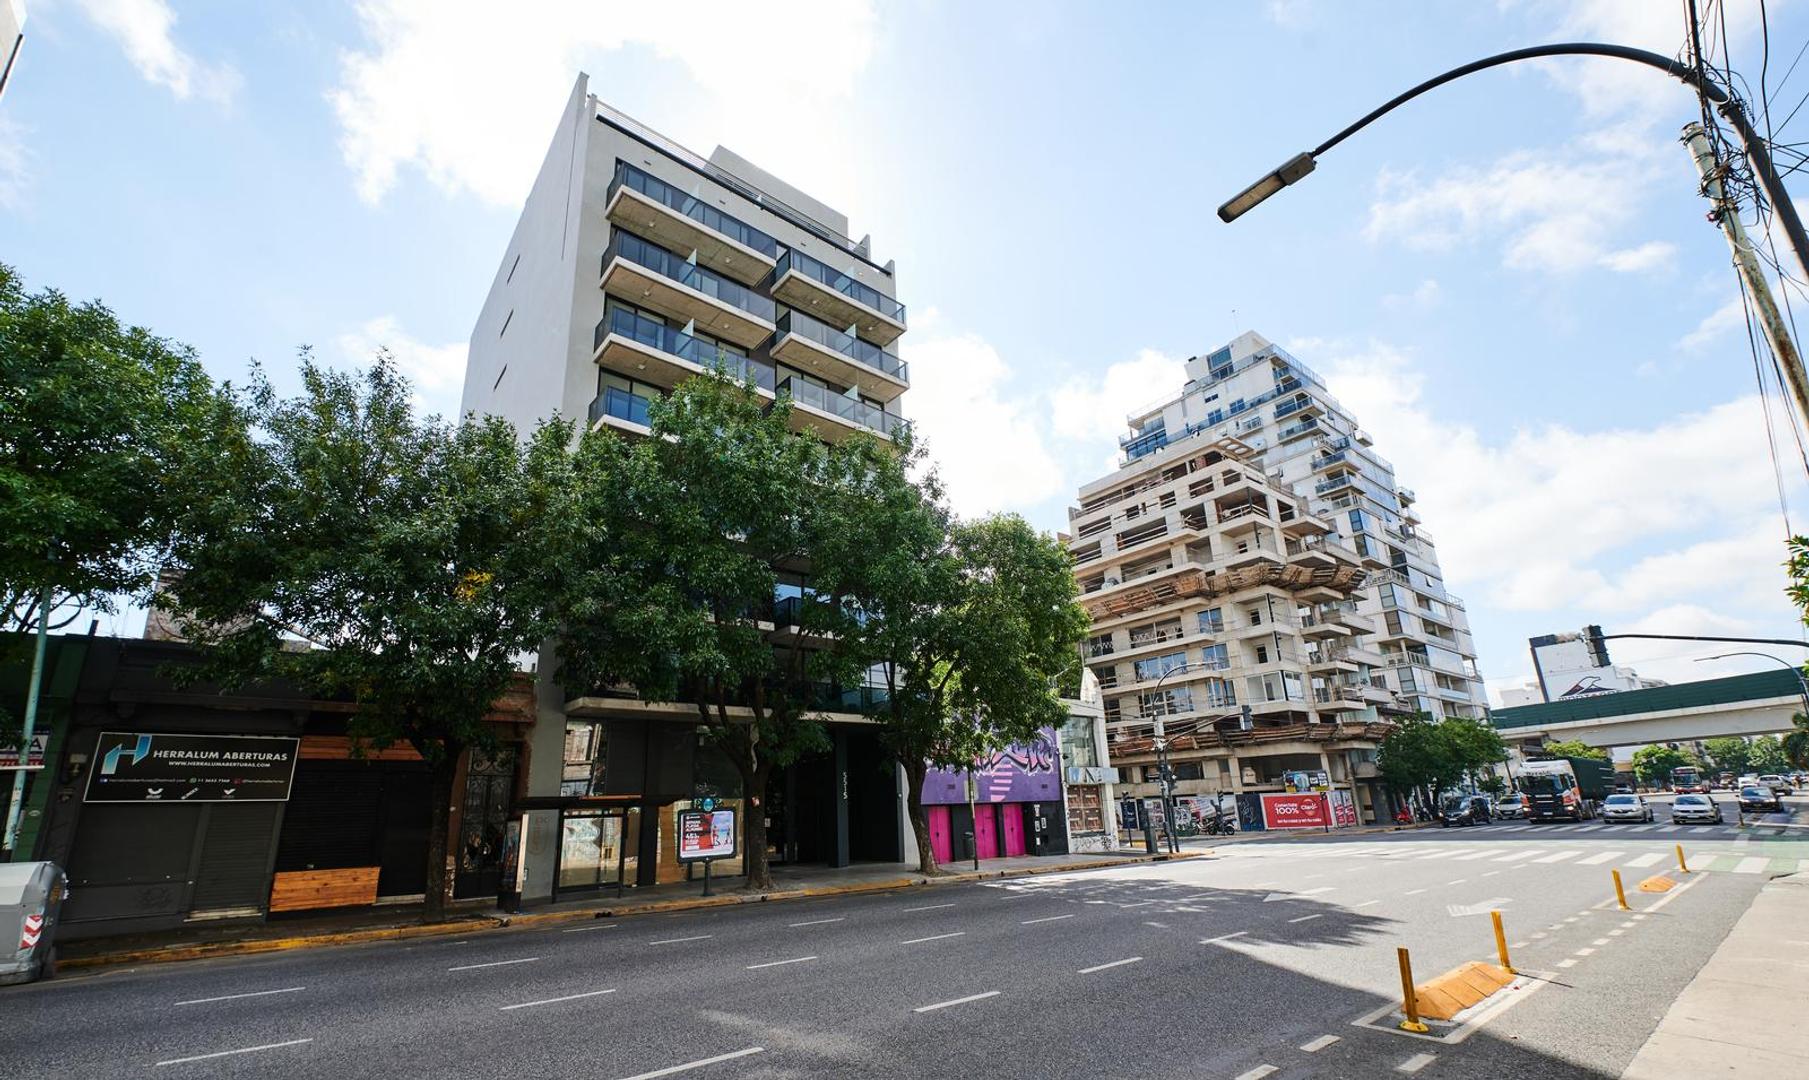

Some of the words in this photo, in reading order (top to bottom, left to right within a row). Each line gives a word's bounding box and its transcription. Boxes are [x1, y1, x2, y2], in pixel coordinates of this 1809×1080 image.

[153, 749, 219, 759] HERRALUM
[222, 751, 288, 761] ABERTURAS
[1275, 807, 1299, 815] 100%
